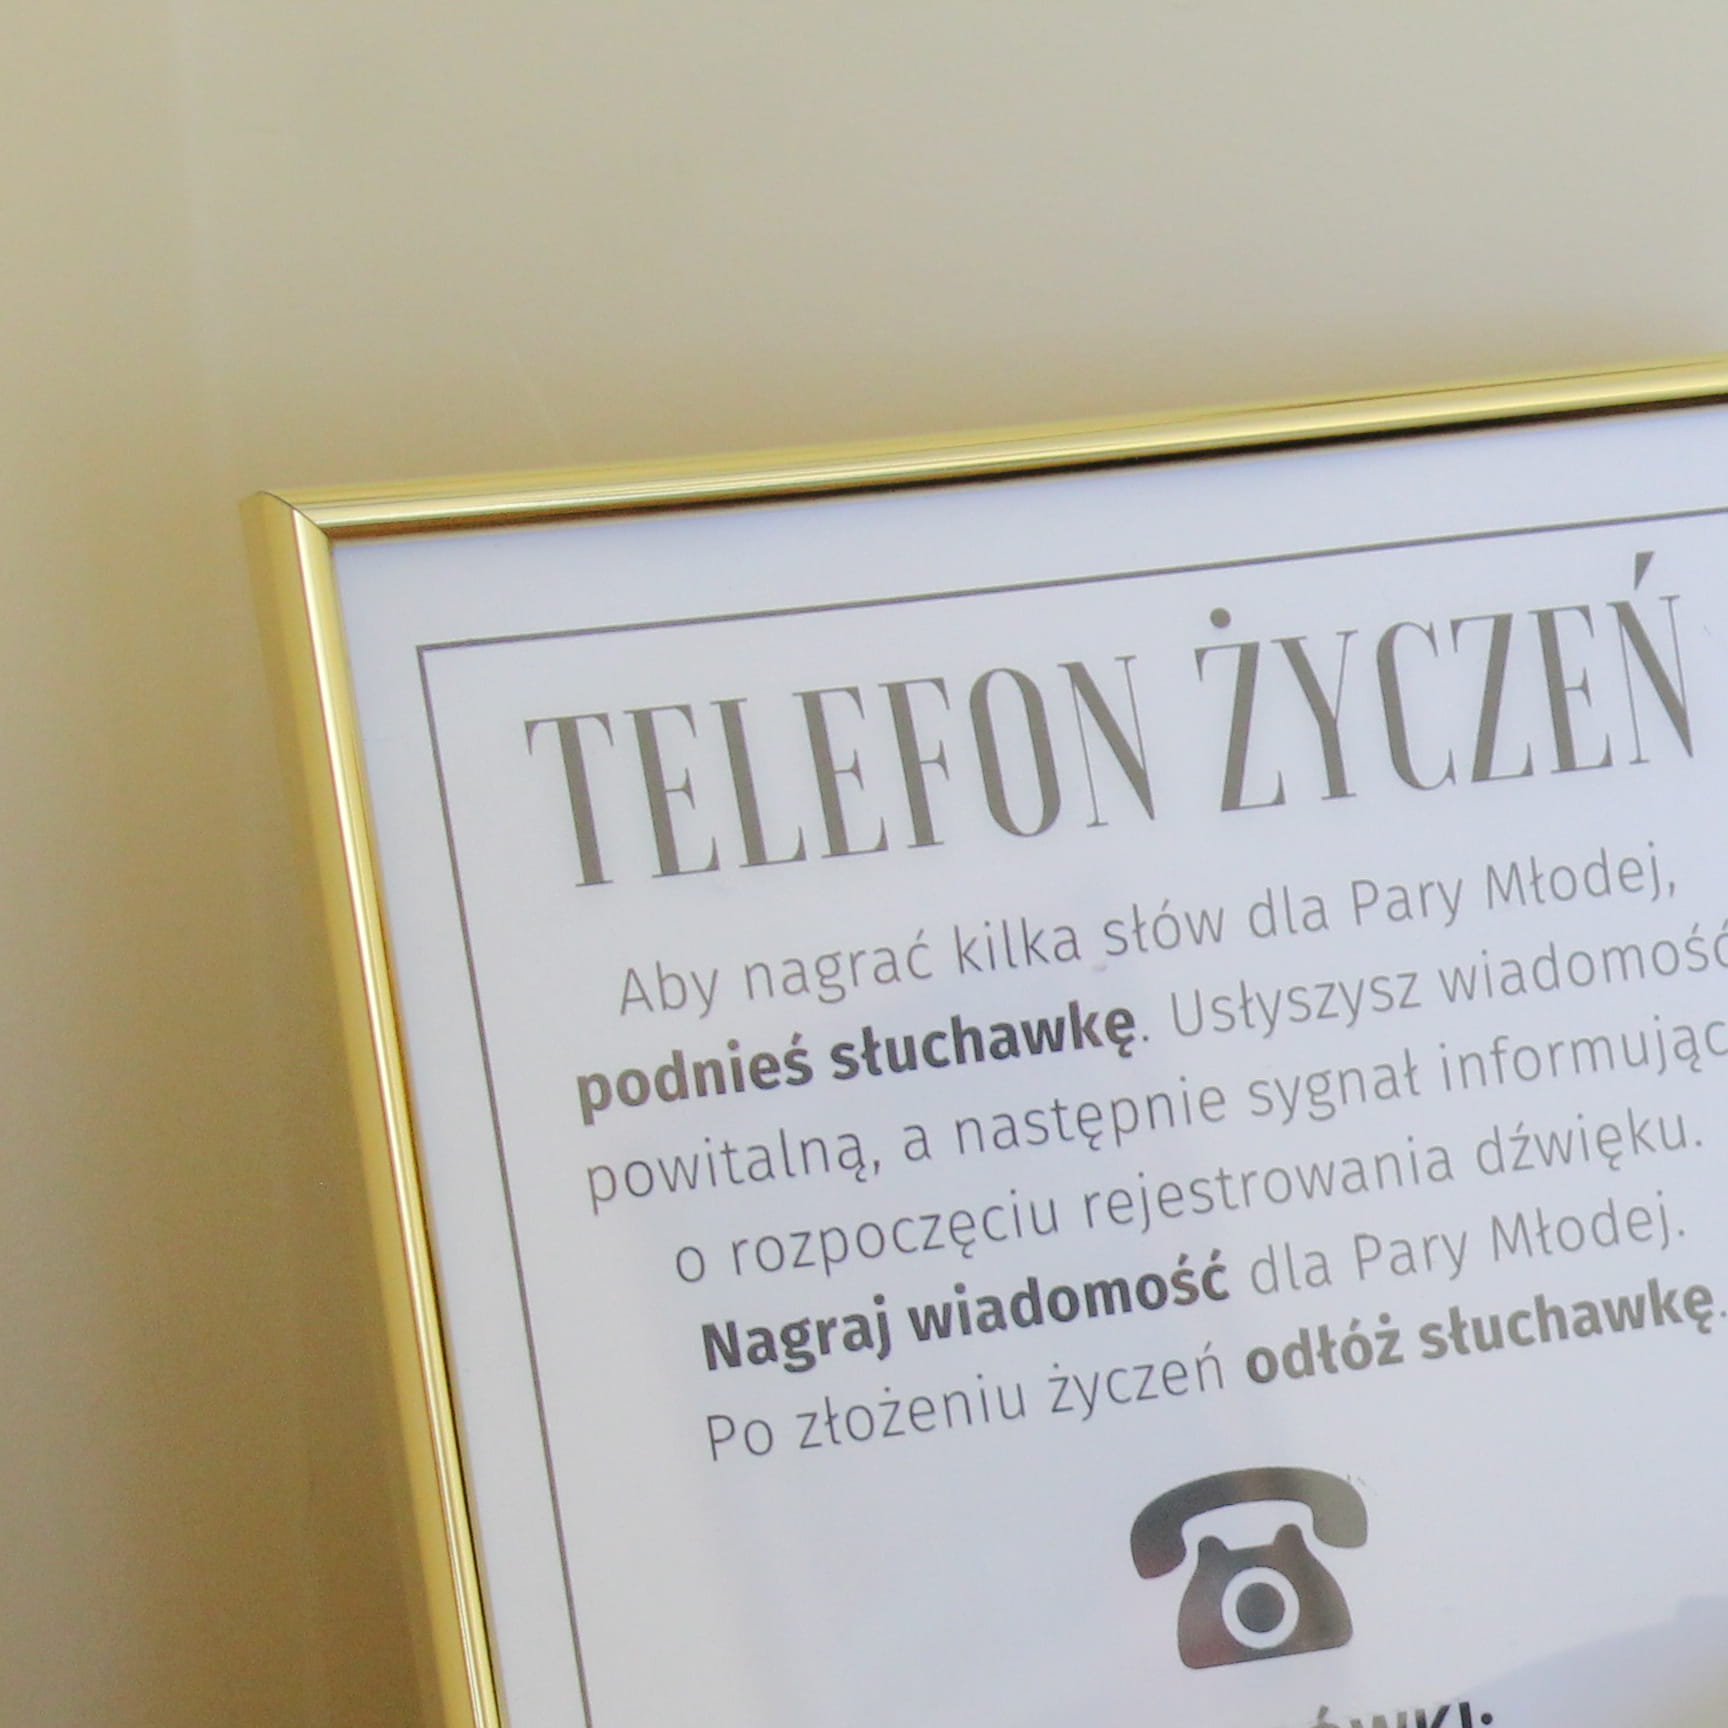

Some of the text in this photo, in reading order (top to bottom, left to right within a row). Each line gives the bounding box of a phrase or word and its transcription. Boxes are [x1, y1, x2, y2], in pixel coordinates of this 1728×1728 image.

[523, 551, 1694, 887] TELEFON ŻYCZEŃ
[620, 840, 1676, 1020] Aby nagrać kilka słów dla Pary Młodej,
[577, 1031, 813, 1127] podnieś
[830, 1000, 1149, 1081] słuchawkę.
[1171, 972, 1422, 1039] Usłyszysz
[586, 1128, 880, 1217] powitalną,
[903, 1124, 932, 1162] a
[955, 1075, 1226, 1155] następnie
[1248, 1047, 1421, 1126] sygnał
[675, 1107, 1702, 1284] o rozpoczęciu rejestrowania dźwięku.
[701, 1189, 1685, 1374] Nagraj wiadomość dla Pary Młodej.
[706, 1277, 1727, 1462] Po złożeniu życzeń odłóż słuchawkę.
